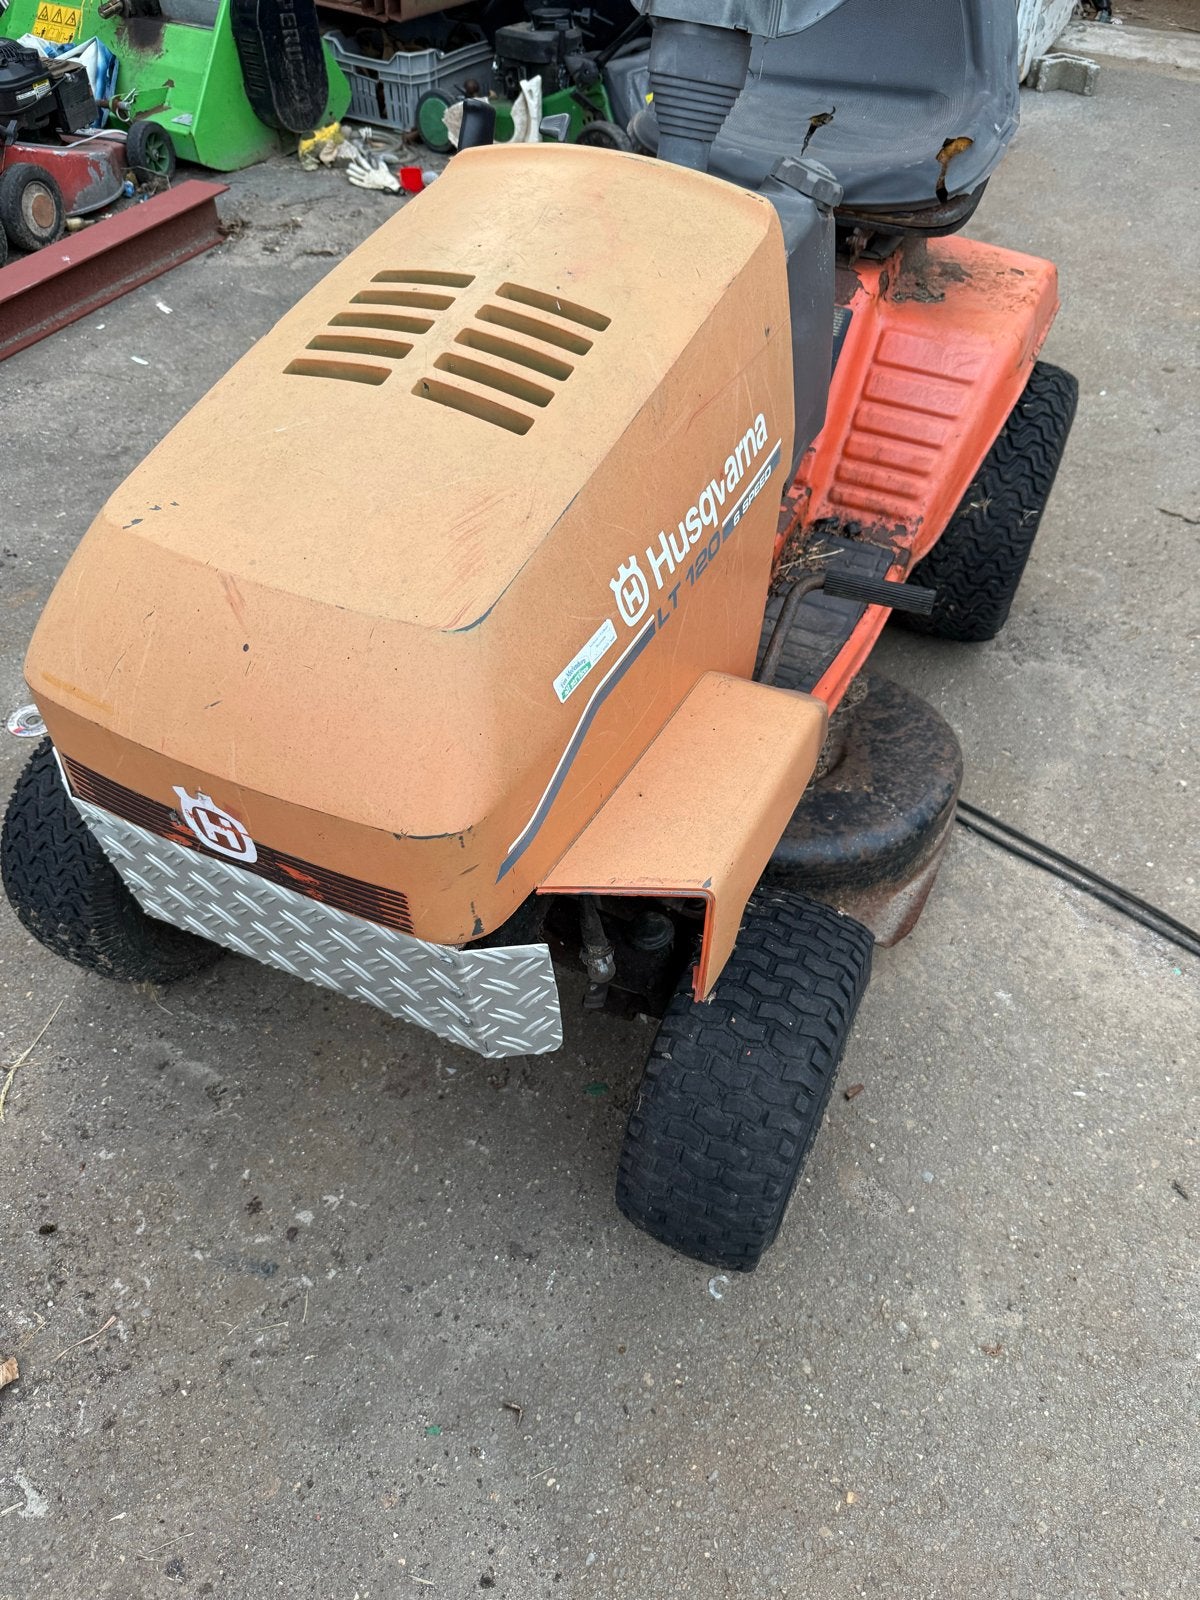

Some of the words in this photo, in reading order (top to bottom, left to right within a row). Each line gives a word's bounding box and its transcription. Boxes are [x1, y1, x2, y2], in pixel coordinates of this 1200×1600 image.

[645, 412, 768, 590] Husqvarna
[733, 510, 741, 527] 6
[742, 465, 772, 514] SPEED
[657, 581, 681, 629] LT
[685, 530, 721, 587] 120
